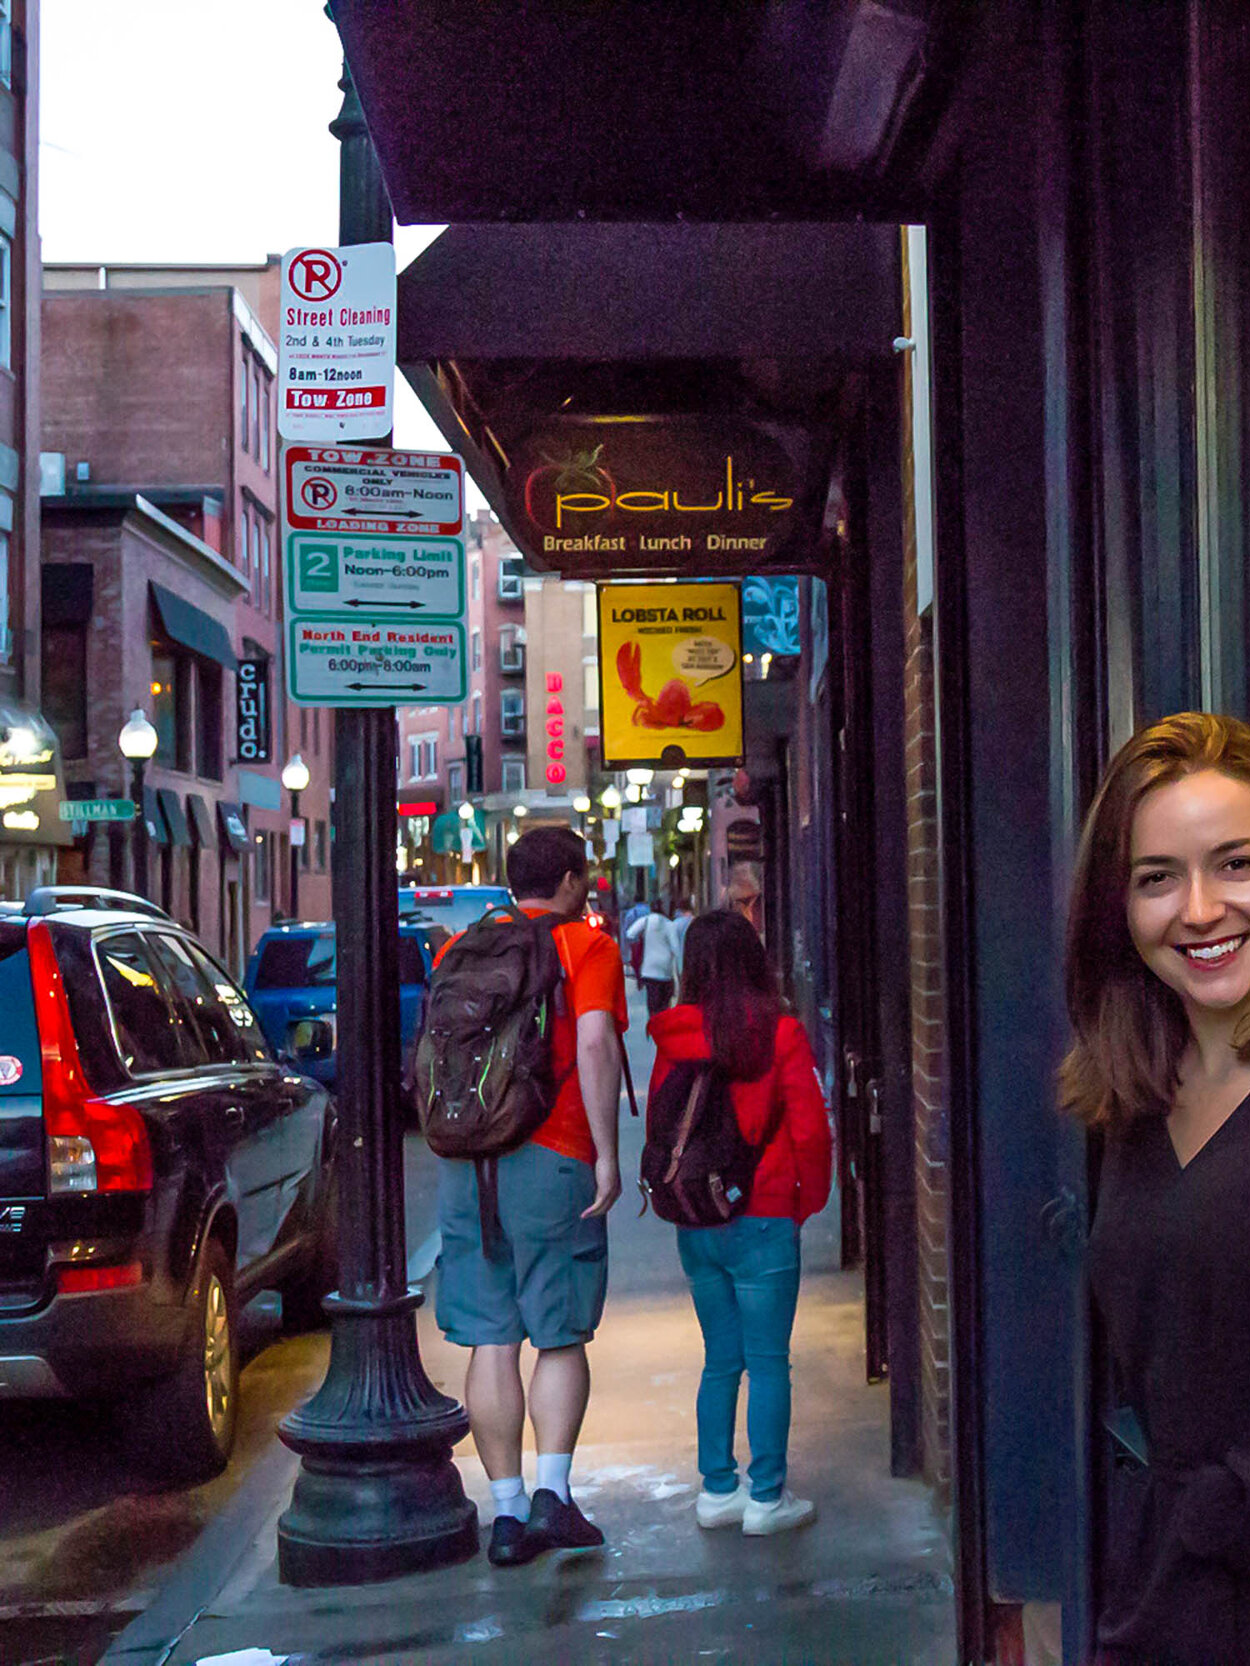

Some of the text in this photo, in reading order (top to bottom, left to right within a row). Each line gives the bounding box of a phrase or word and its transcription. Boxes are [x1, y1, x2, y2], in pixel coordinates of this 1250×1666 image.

[286, 305, 391, 327] Street Cleaning
[286, 335, 385, 347] 2nd & 4th Tuesday
[289, 367, 362, 381] 8am-12noon
[291, 390, 373, 407] Tow Zone
[308, 449, 441, 468] TOW ZONE
[304, 465, 387, 477] COMMERCIAL
[362, 478, 393, 486] ONLY
[345, 485, 454, 501] 8:00am-Noon
[316, 519, 441, 534] LOADING ZONE
[544, 533, 768, 551] Breakfast Lunch Dinner
[343, 546, 453, 563] Parking Limit
[306, 551, 332, 577] 2
[344, 564, 450, 579] Noon-6:00pm
[612, 606, 727, 623] LOBSTA ROLL
[302, 629, 454, 644] North End Resident
[299, 643, 351, 656] Permit
[424, 645, 457, 660] Only
